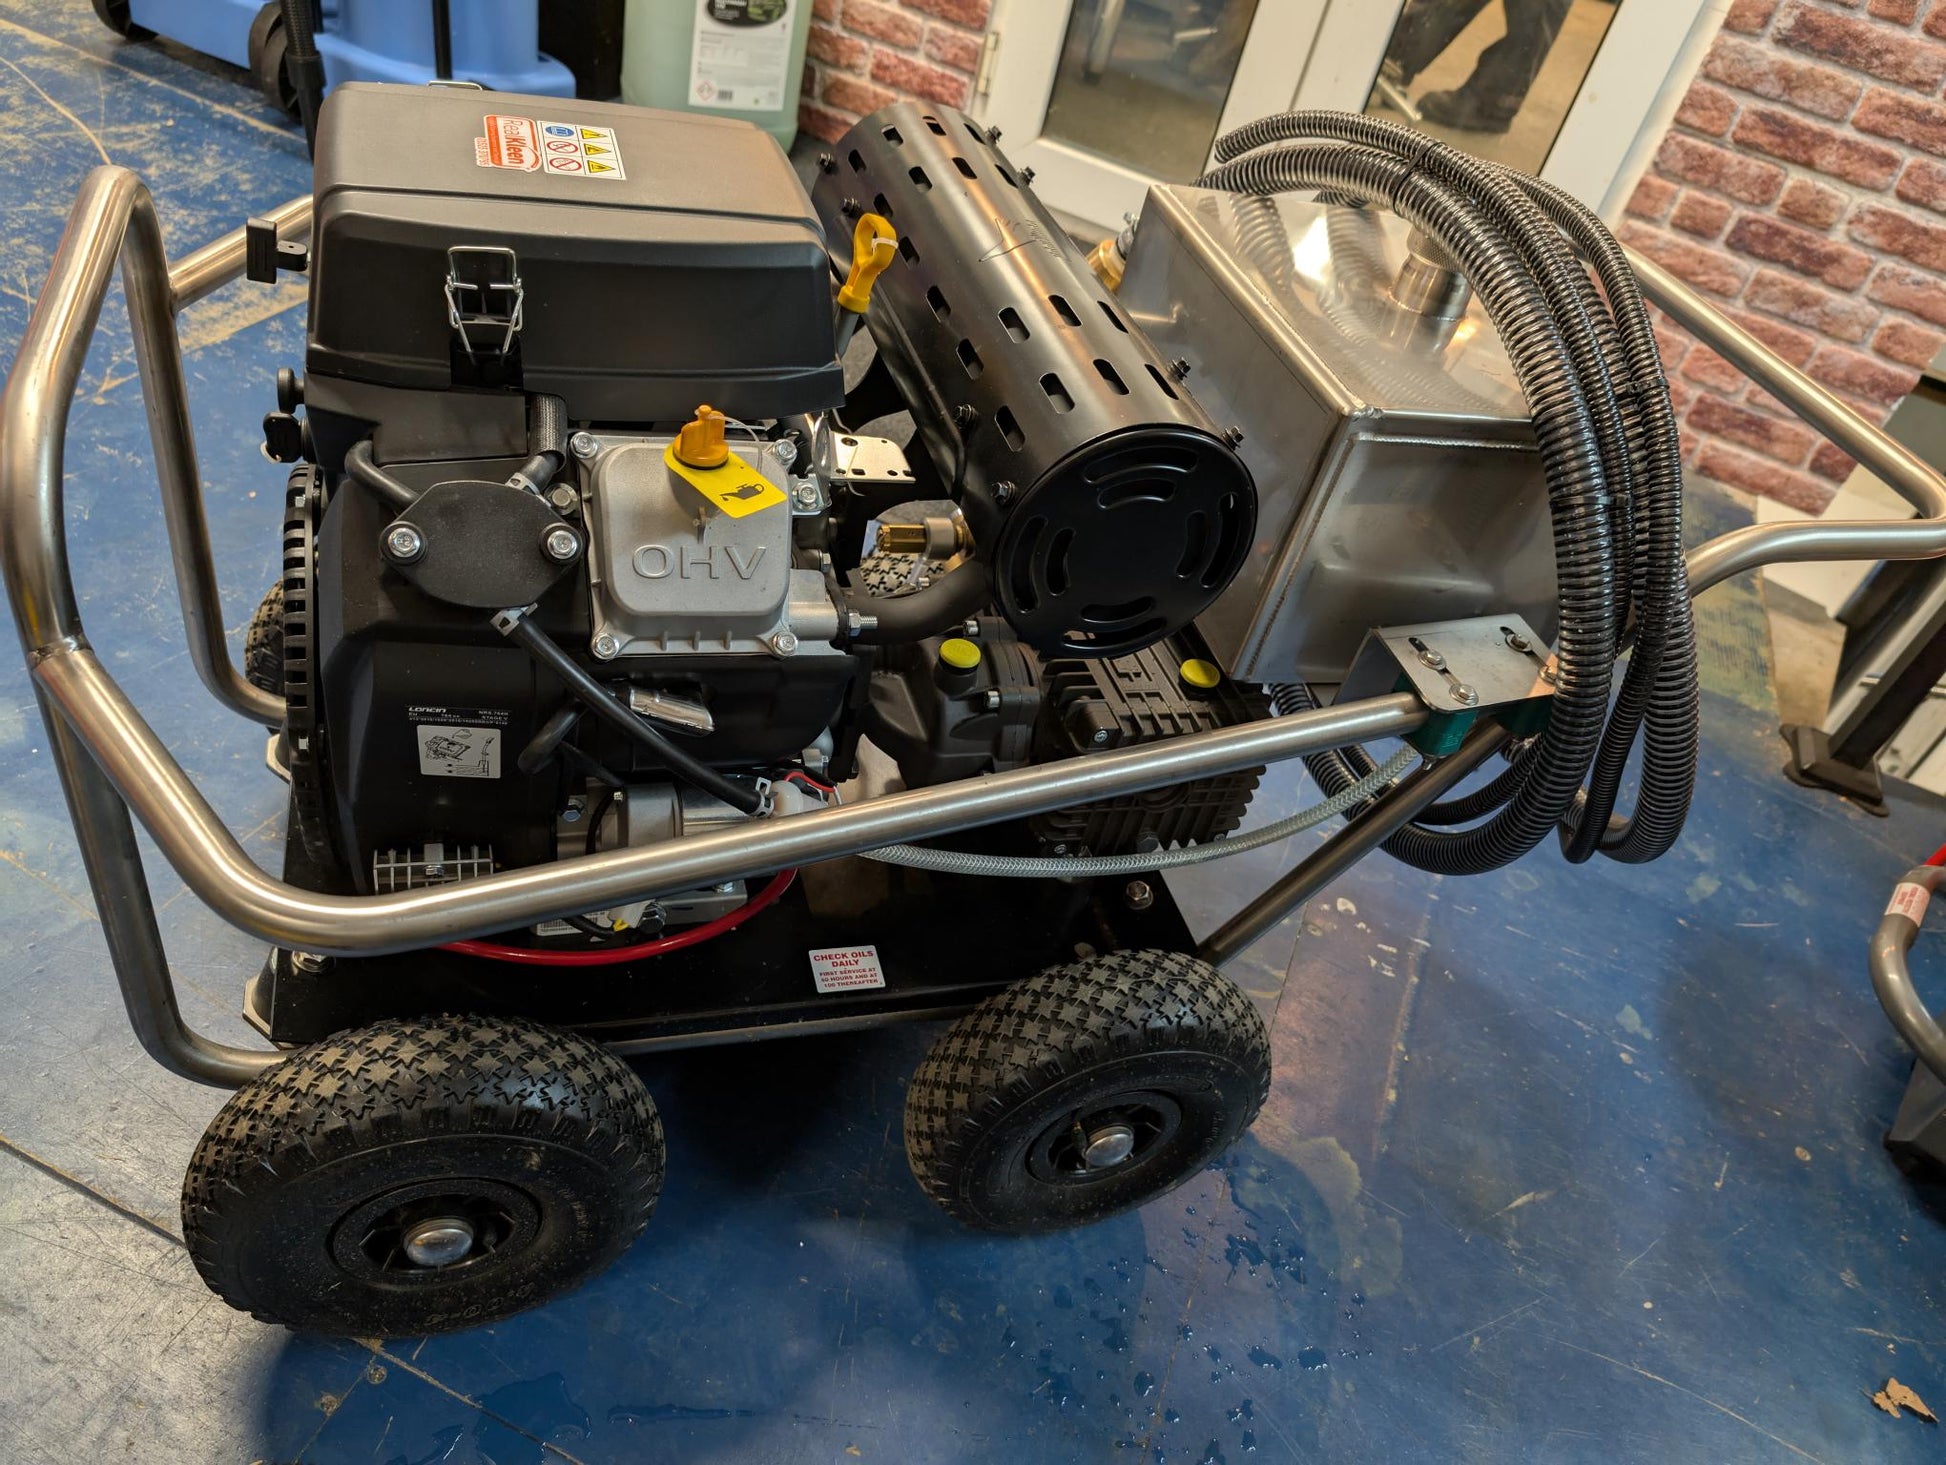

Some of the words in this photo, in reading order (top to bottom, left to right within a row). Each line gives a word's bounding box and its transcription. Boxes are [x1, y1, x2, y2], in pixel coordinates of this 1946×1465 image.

[632, 544, 767, 580] OHV
[813, 952, 849, 962] CHECK
[851, 950, 874, 958] OILS
[831, 959, 859, 968] DAILY
[837, 979, 879, 987] THEREAFTER
